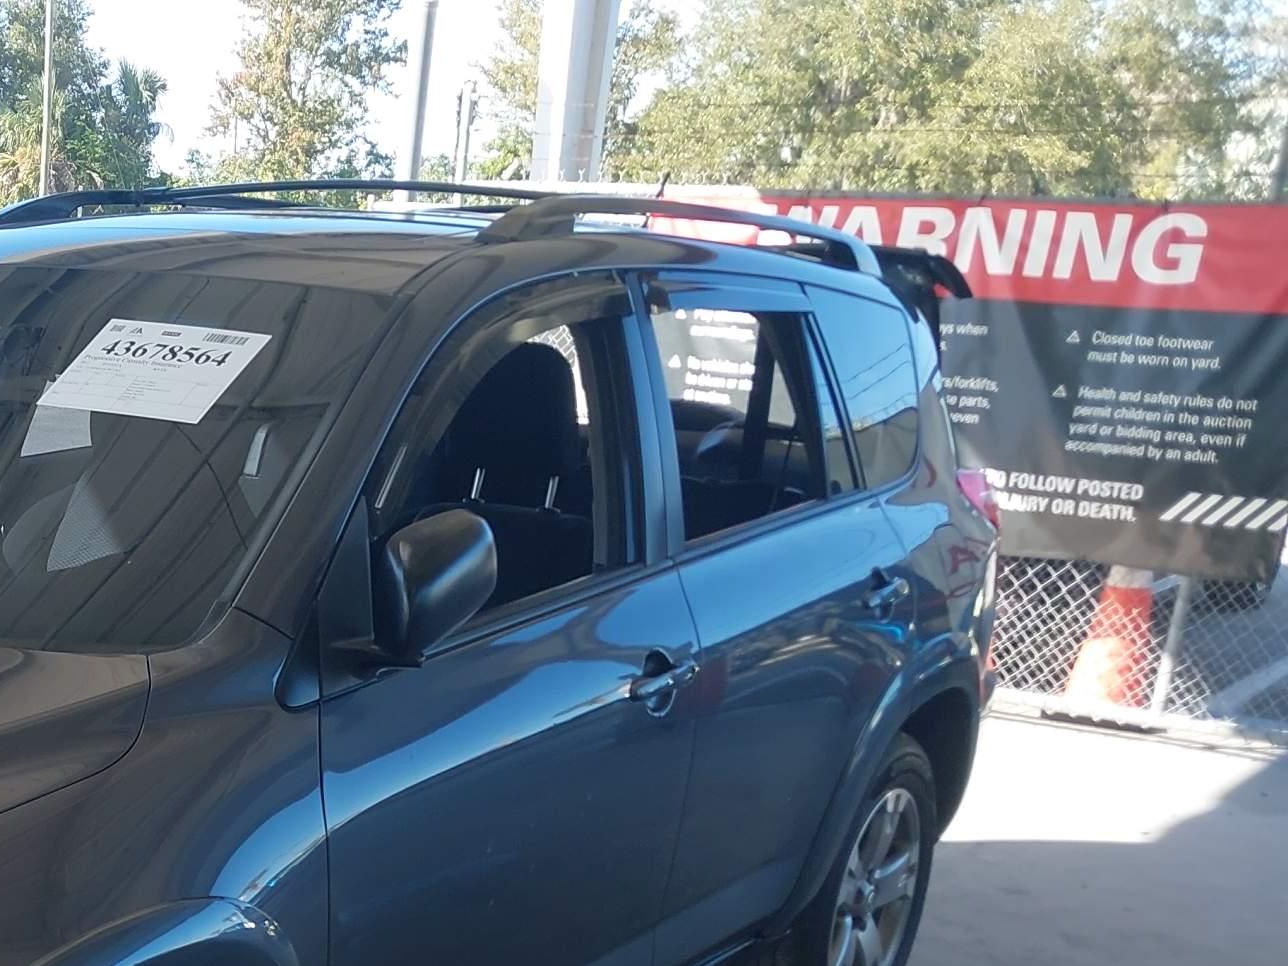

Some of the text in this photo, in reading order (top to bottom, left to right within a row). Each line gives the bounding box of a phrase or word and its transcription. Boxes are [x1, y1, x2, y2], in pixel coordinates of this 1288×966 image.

[754, 205, 1208, 285] WARNING
[1092, 330, 1214, 351] Closed toe footwear
[101, 339, 233, 368] 43678564
[1087, 350, 1222, 371] must be worn on yard.
[1078, 385, 1258, 411] Health and safety rules do not
[1072, 405, 1252, 430] permit children in the auction
[1068, 423, 1247, 448] yard or bidding area, even if
[1065, 440, 1219, 463] accompanied by an adult.
[1008, 471, 1076, 495] FOLLOW
[1077, 478, 1144, 501] POSTED
[1051, 498, 1075, 516] OR
[1077, 500, 1137, 522] DEATH.
